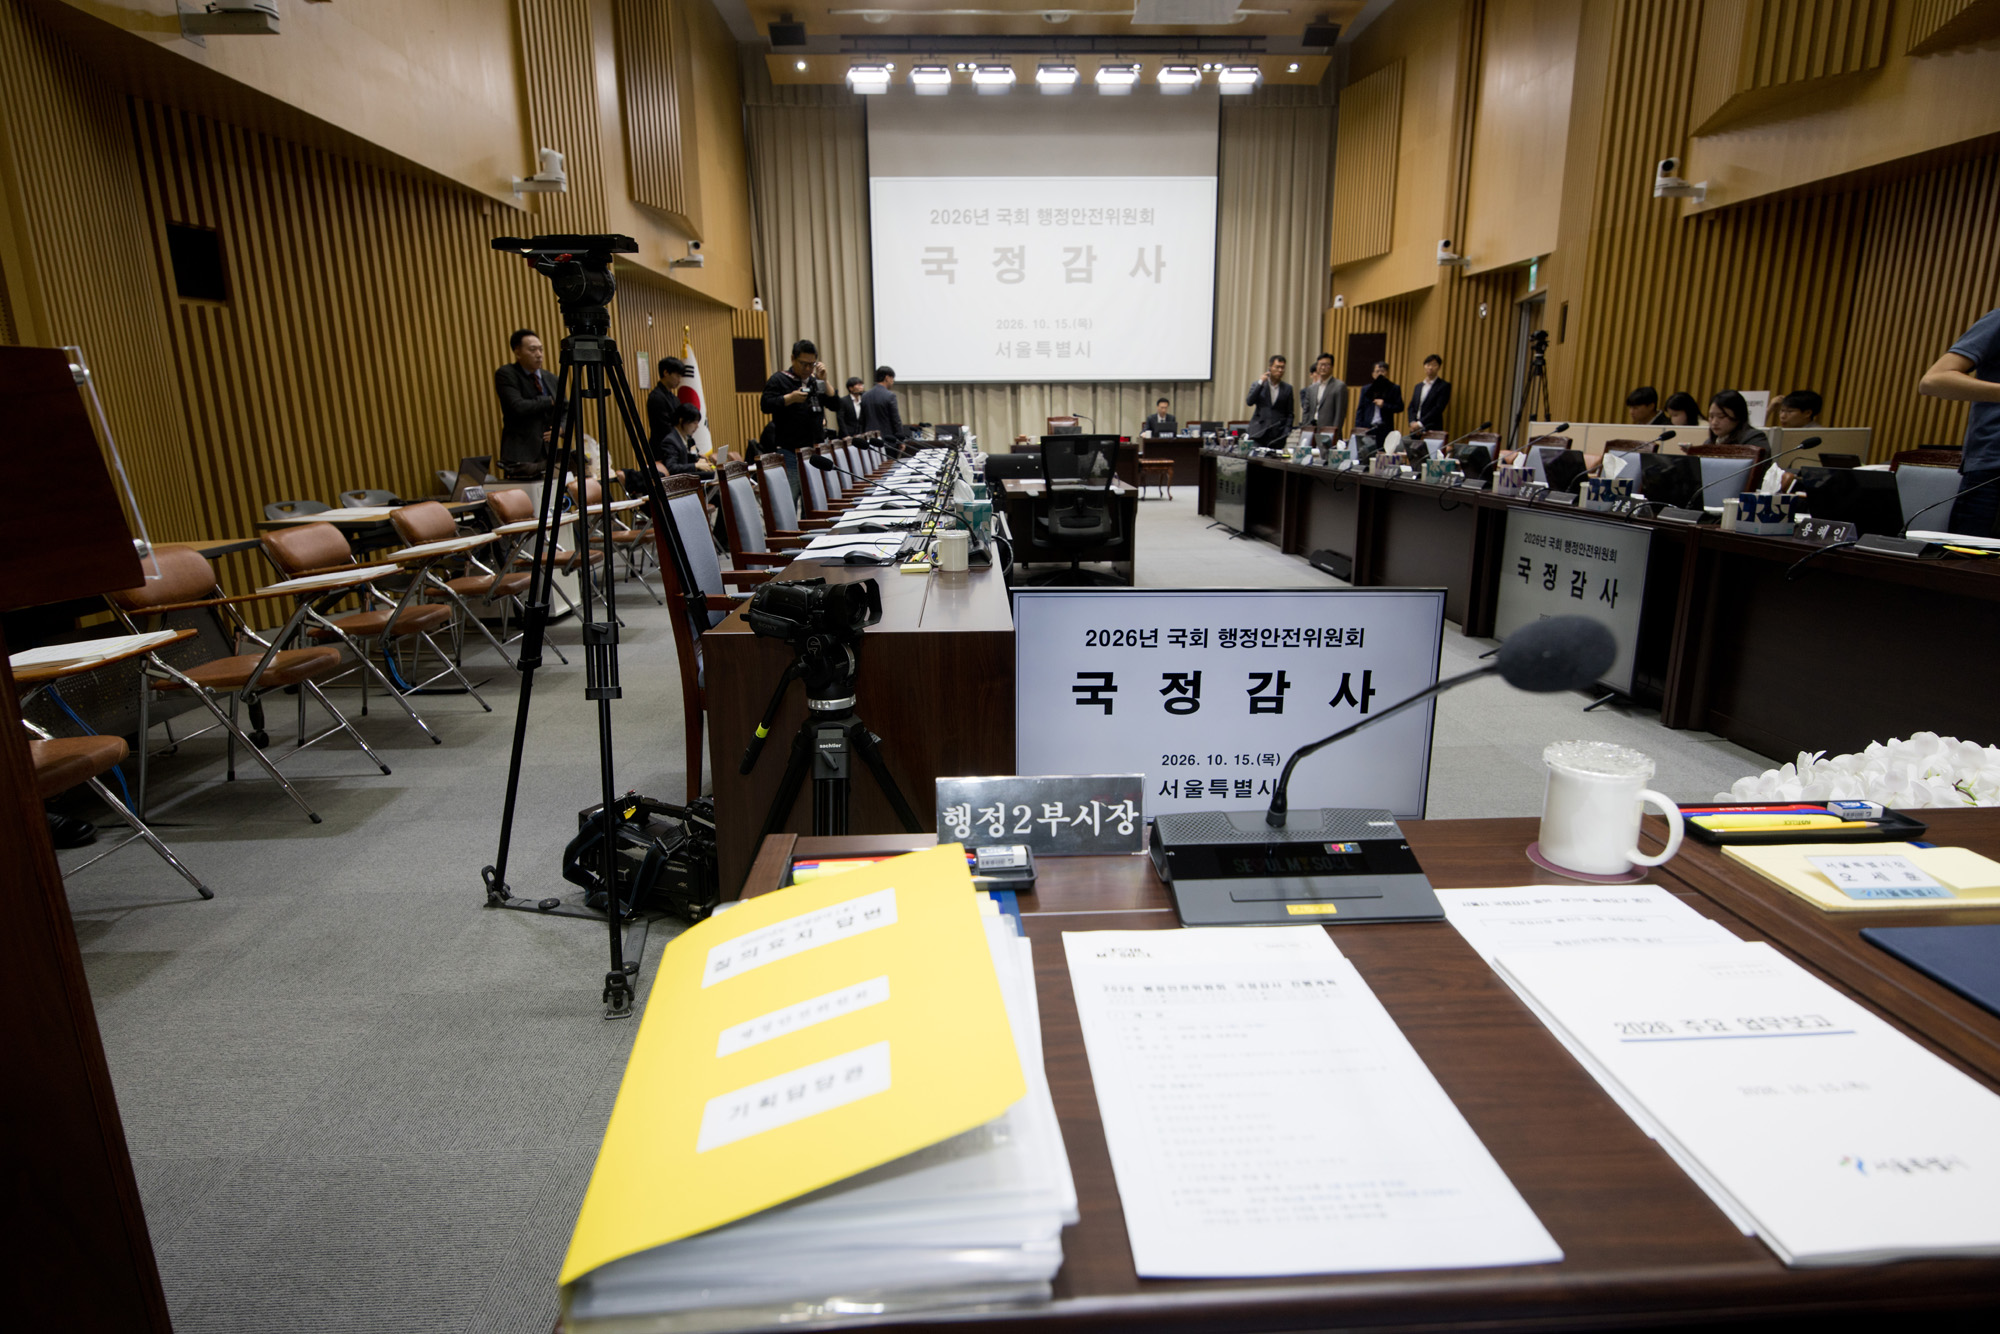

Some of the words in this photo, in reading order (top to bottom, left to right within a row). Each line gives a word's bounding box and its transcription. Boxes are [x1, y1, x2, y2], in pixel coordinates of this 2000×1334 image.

[930, 208, 990, 226] 2026년
[996, 208, 1030, 226] 국회
[1037, 207, 1155, 226] 행정안전위원회
[996, 319, 1028, 330] 2026.
[1033, 319, 1050, 330] 10.
[995, 340, 1092, 359] 서울특별시
[1524, 532, 1547, 548] 2026년
[1548, 536, 1563, 551] 국회
[1564, 541, 1618, 564] 행정안전위원회
[1085, 628, 1158, 648] 2026년
[1167, 628, 1209, 648] 국회
[1218, 627, 1365, 648] 행정안전위원회
[1161, 754, 1200, 766] 2026.
[1206, 754, 1227, 766] 10.
[1234, 753, 1281, 767] 15.(목)
[1159, 779, 1278, 799] 서울특별시
[942, 799, 1140, 839] 행정2부시장
[1825, 860, 1907, 870] 서울특별시장
[1873, 888, 1942, 898] 서울특별시
[1615, 1021, 1674, 1036] 2026
[1680, 1018, 1730, 1034] 주요
[1736, 1014, 1835, 1032] 업무보고
